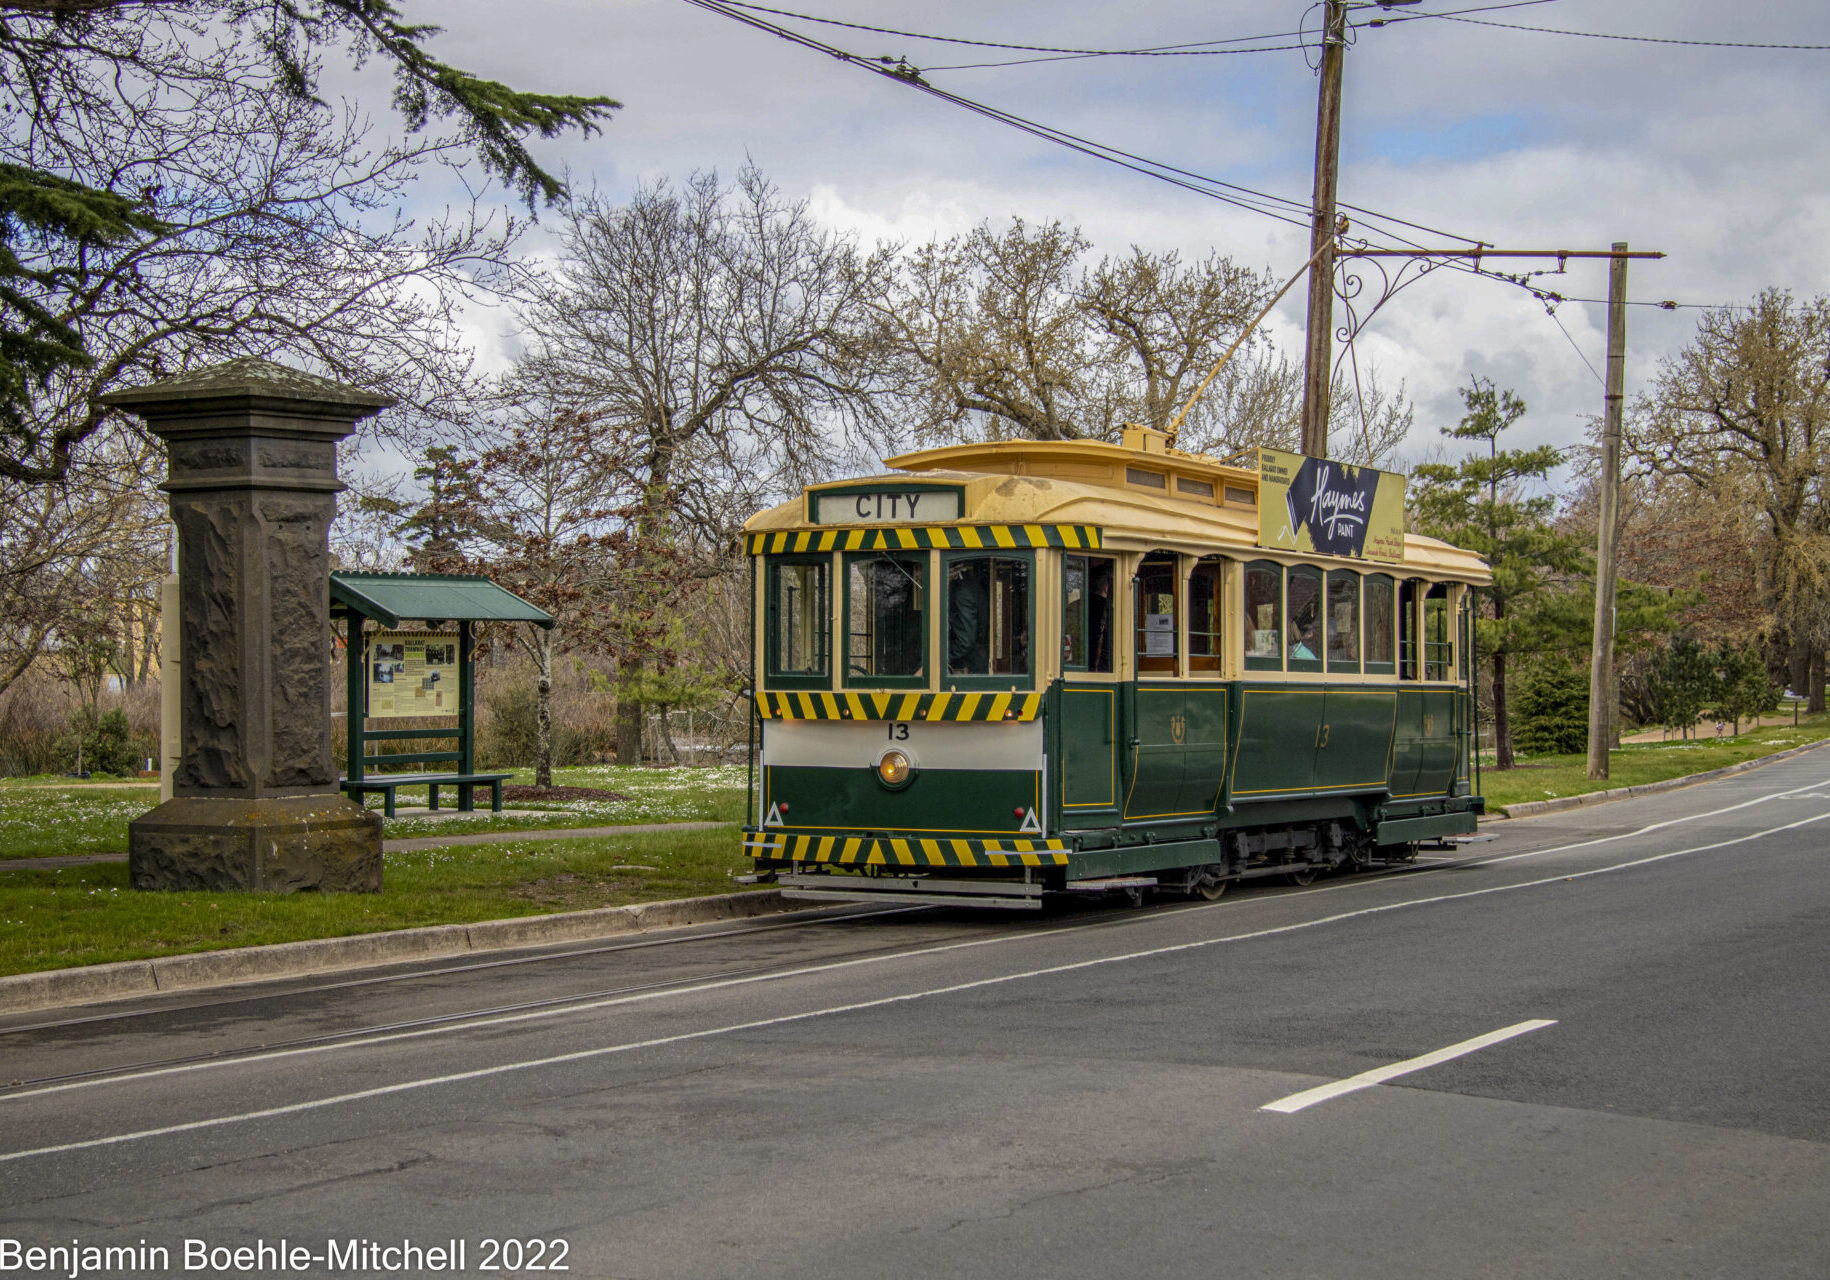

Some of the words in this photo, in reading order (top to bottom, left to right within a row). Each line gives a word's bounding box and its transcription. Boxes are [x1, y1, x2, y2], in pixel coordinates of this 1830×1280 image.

[856, 494, 920, 519] CITY
[1310, 465, 1366, 541] Haymes
[1337, 523, 1354, 539] PAINT
[888, 722, 910, 741] 13
[1314, 724, 1330, 749] 13
